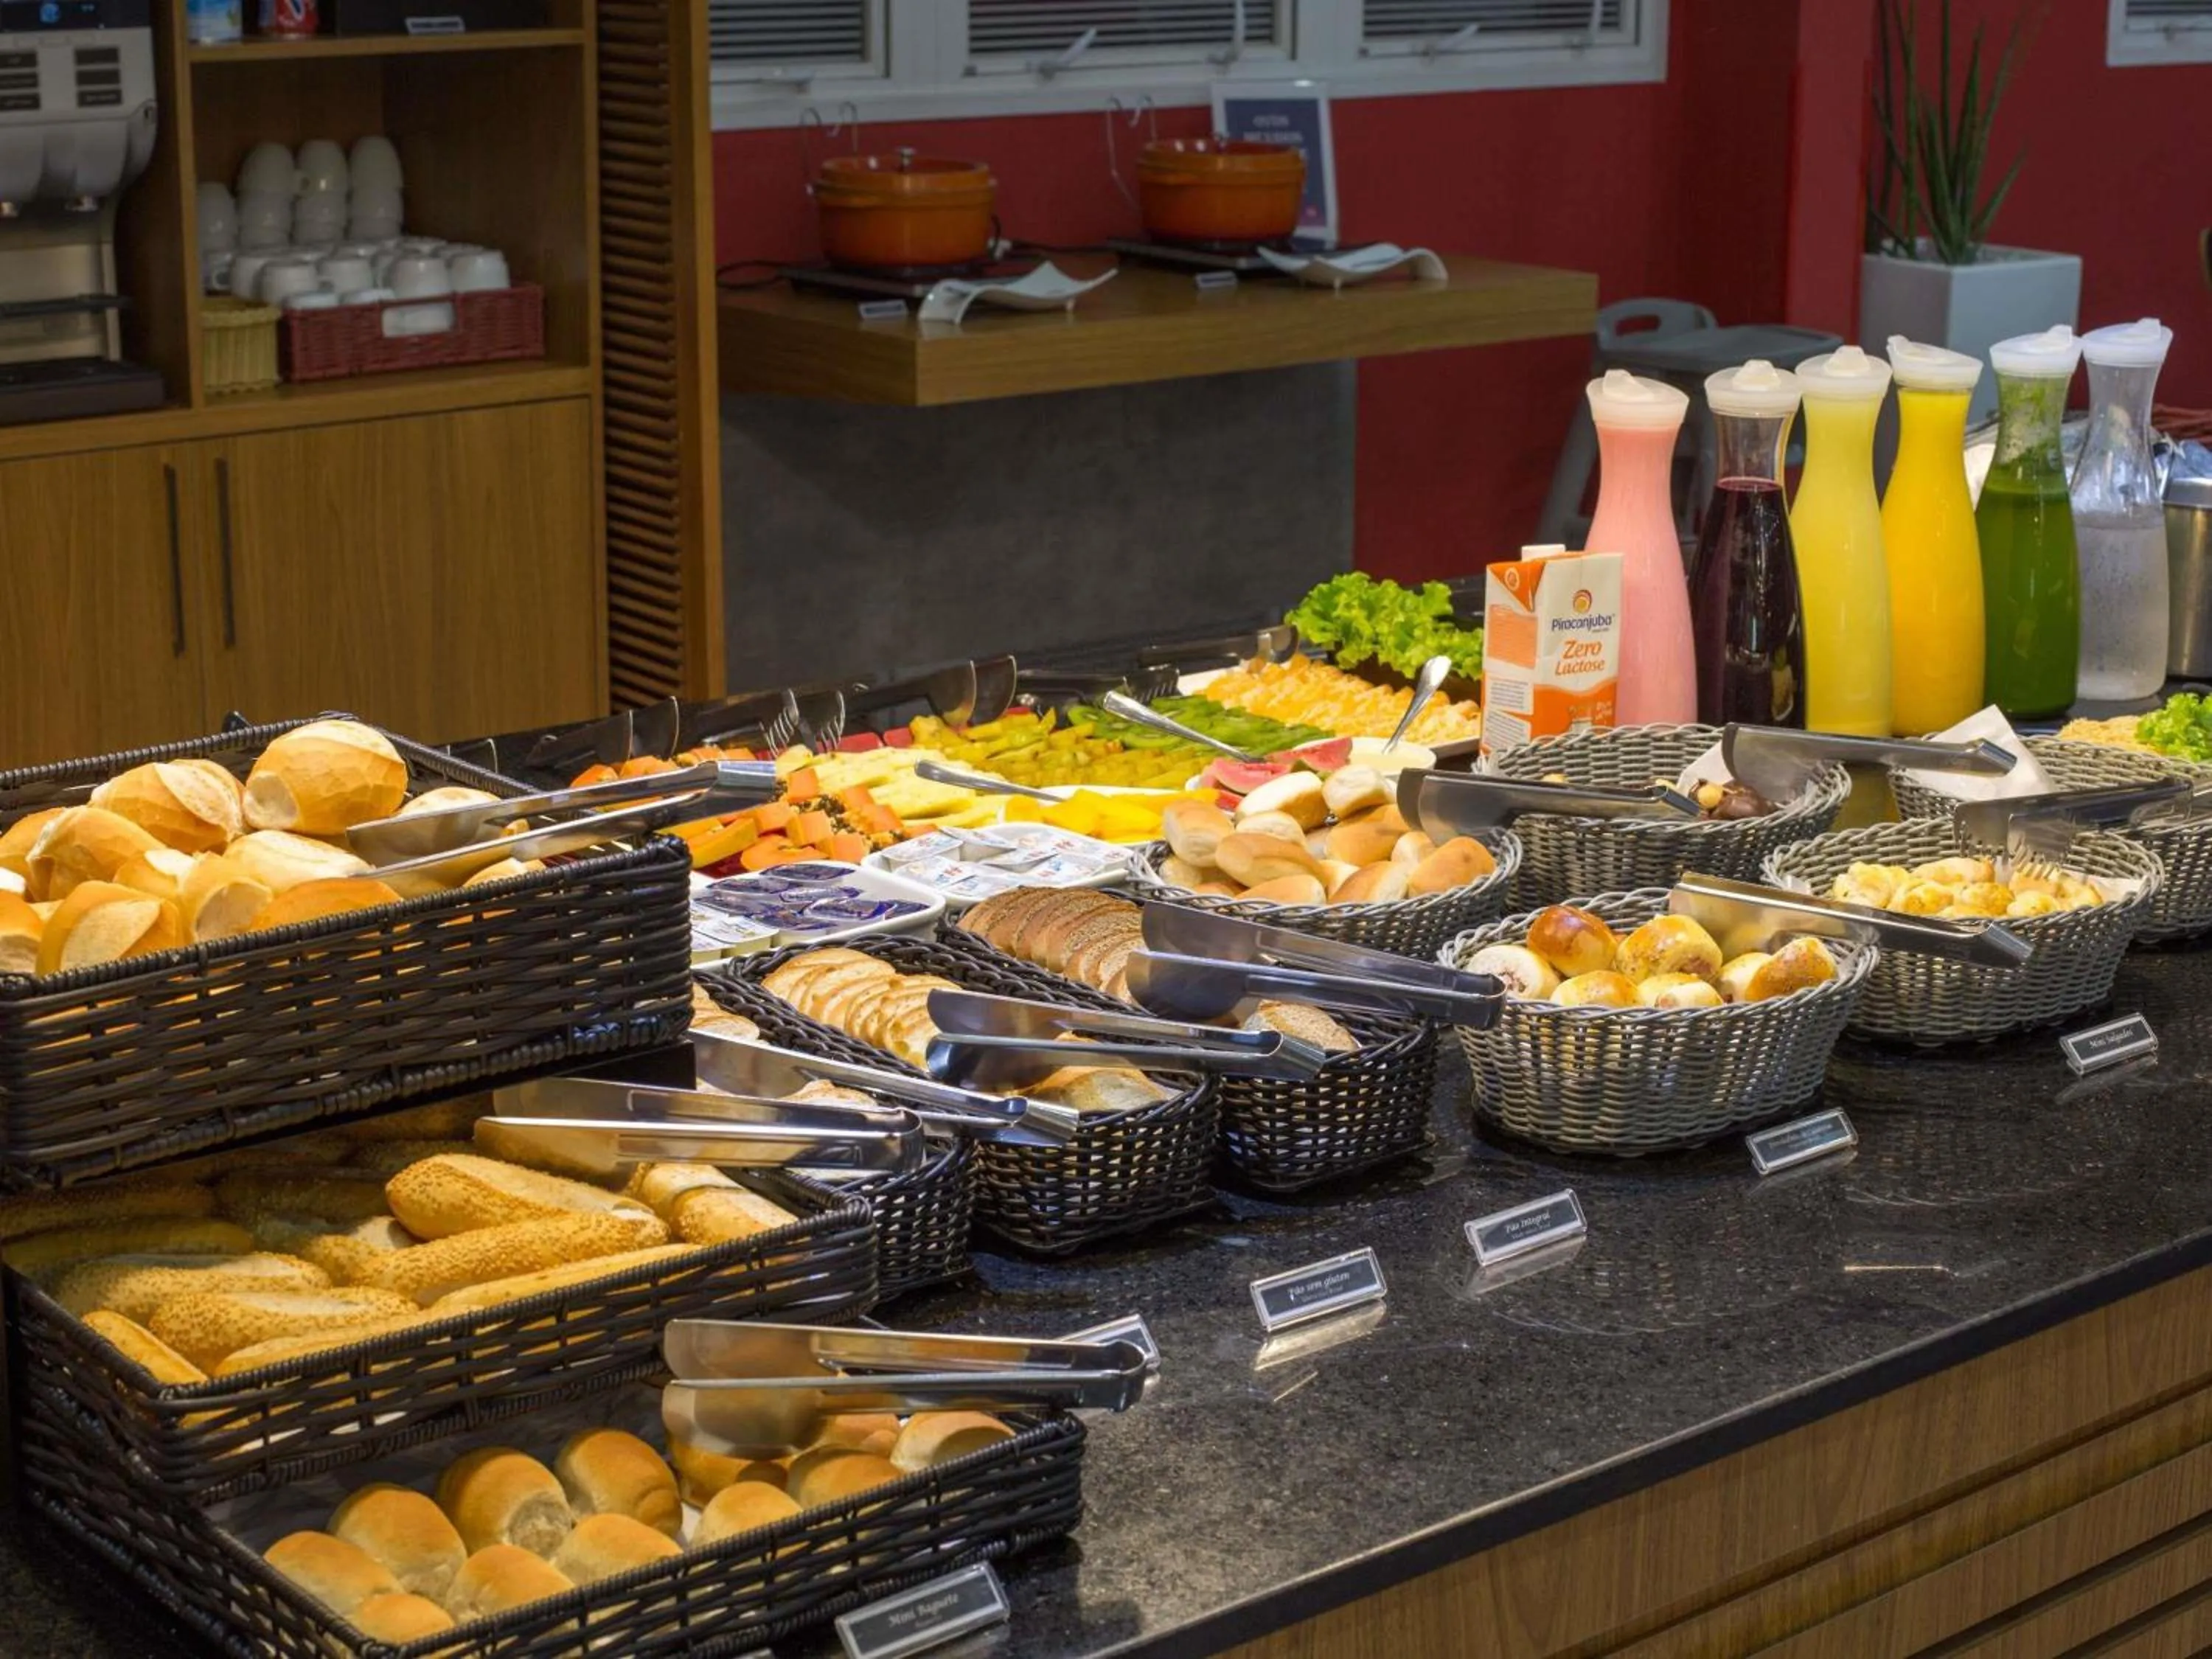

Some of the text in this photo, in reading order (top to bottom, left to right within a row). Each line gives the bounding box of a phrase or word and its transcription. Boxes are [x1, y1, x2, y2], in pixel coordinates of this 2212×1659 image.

[1551, 613, 1612, 632] Piracanjuba
[1563, 639, 1602, 659] Zero
[1555, 660, 1605, 675] Lactose
